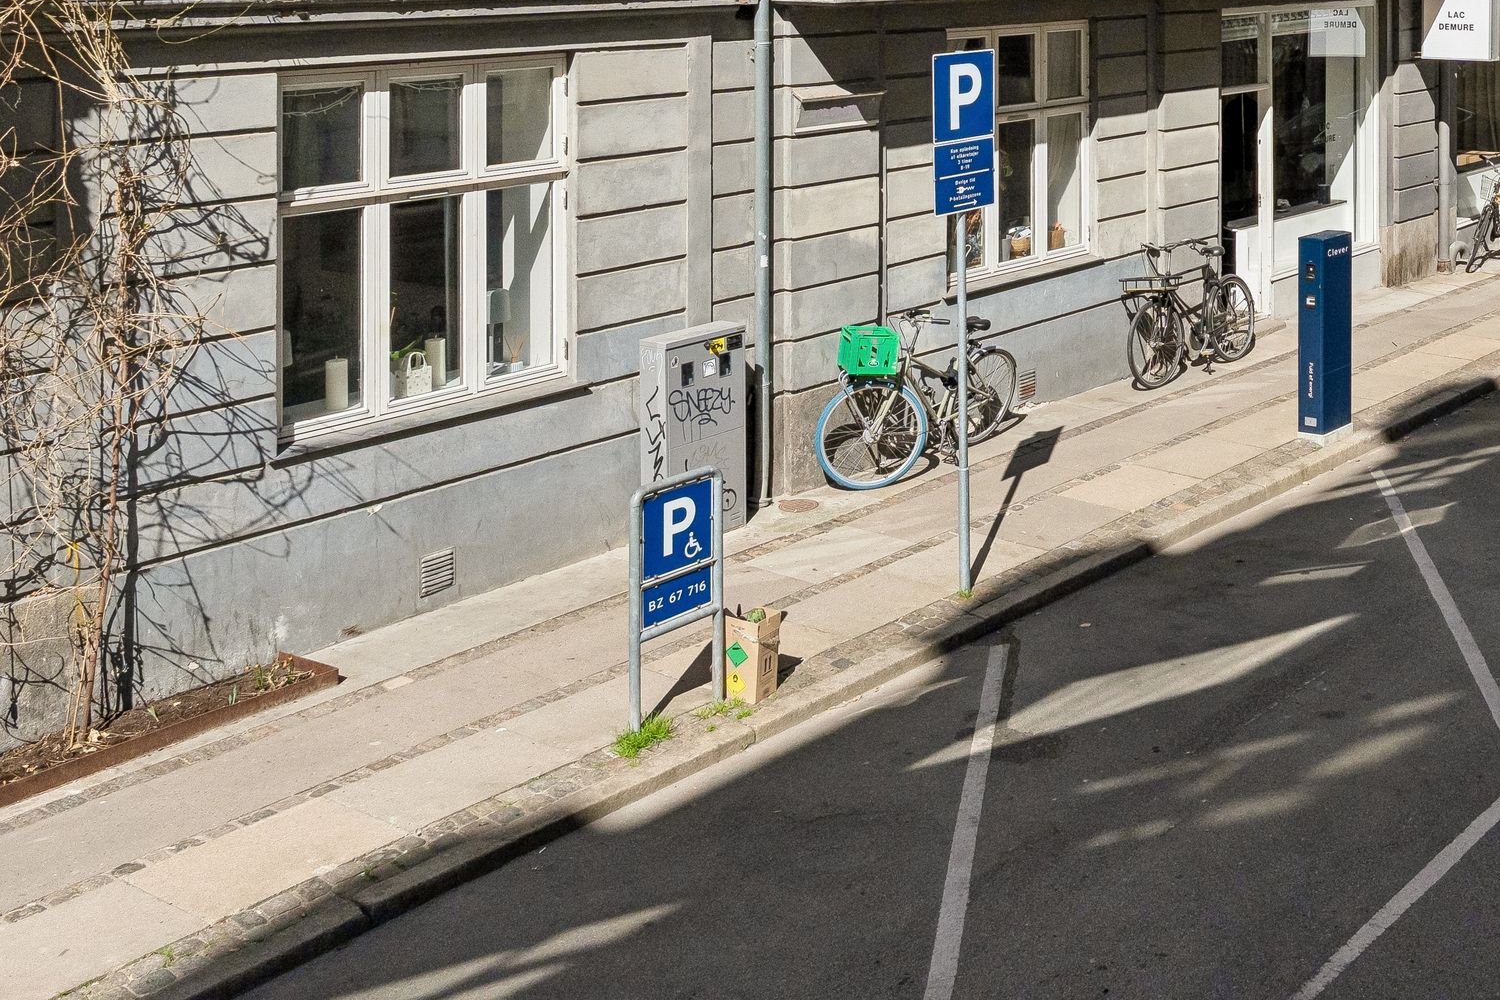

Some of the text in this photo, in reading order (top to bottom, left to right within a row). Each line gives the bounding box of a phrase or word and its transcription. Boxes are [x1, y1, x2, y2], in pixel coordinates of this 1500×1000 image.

[1447, 11, 1465, 19] LAC
[1438, 23, 1475, 31] DEMURE
[950, 62, 982, 131] P
[1327, 246, 1349, 257] Clever
[663, 496, 696, 557] P
[648, 580, 707, 612] BZ 67 716
